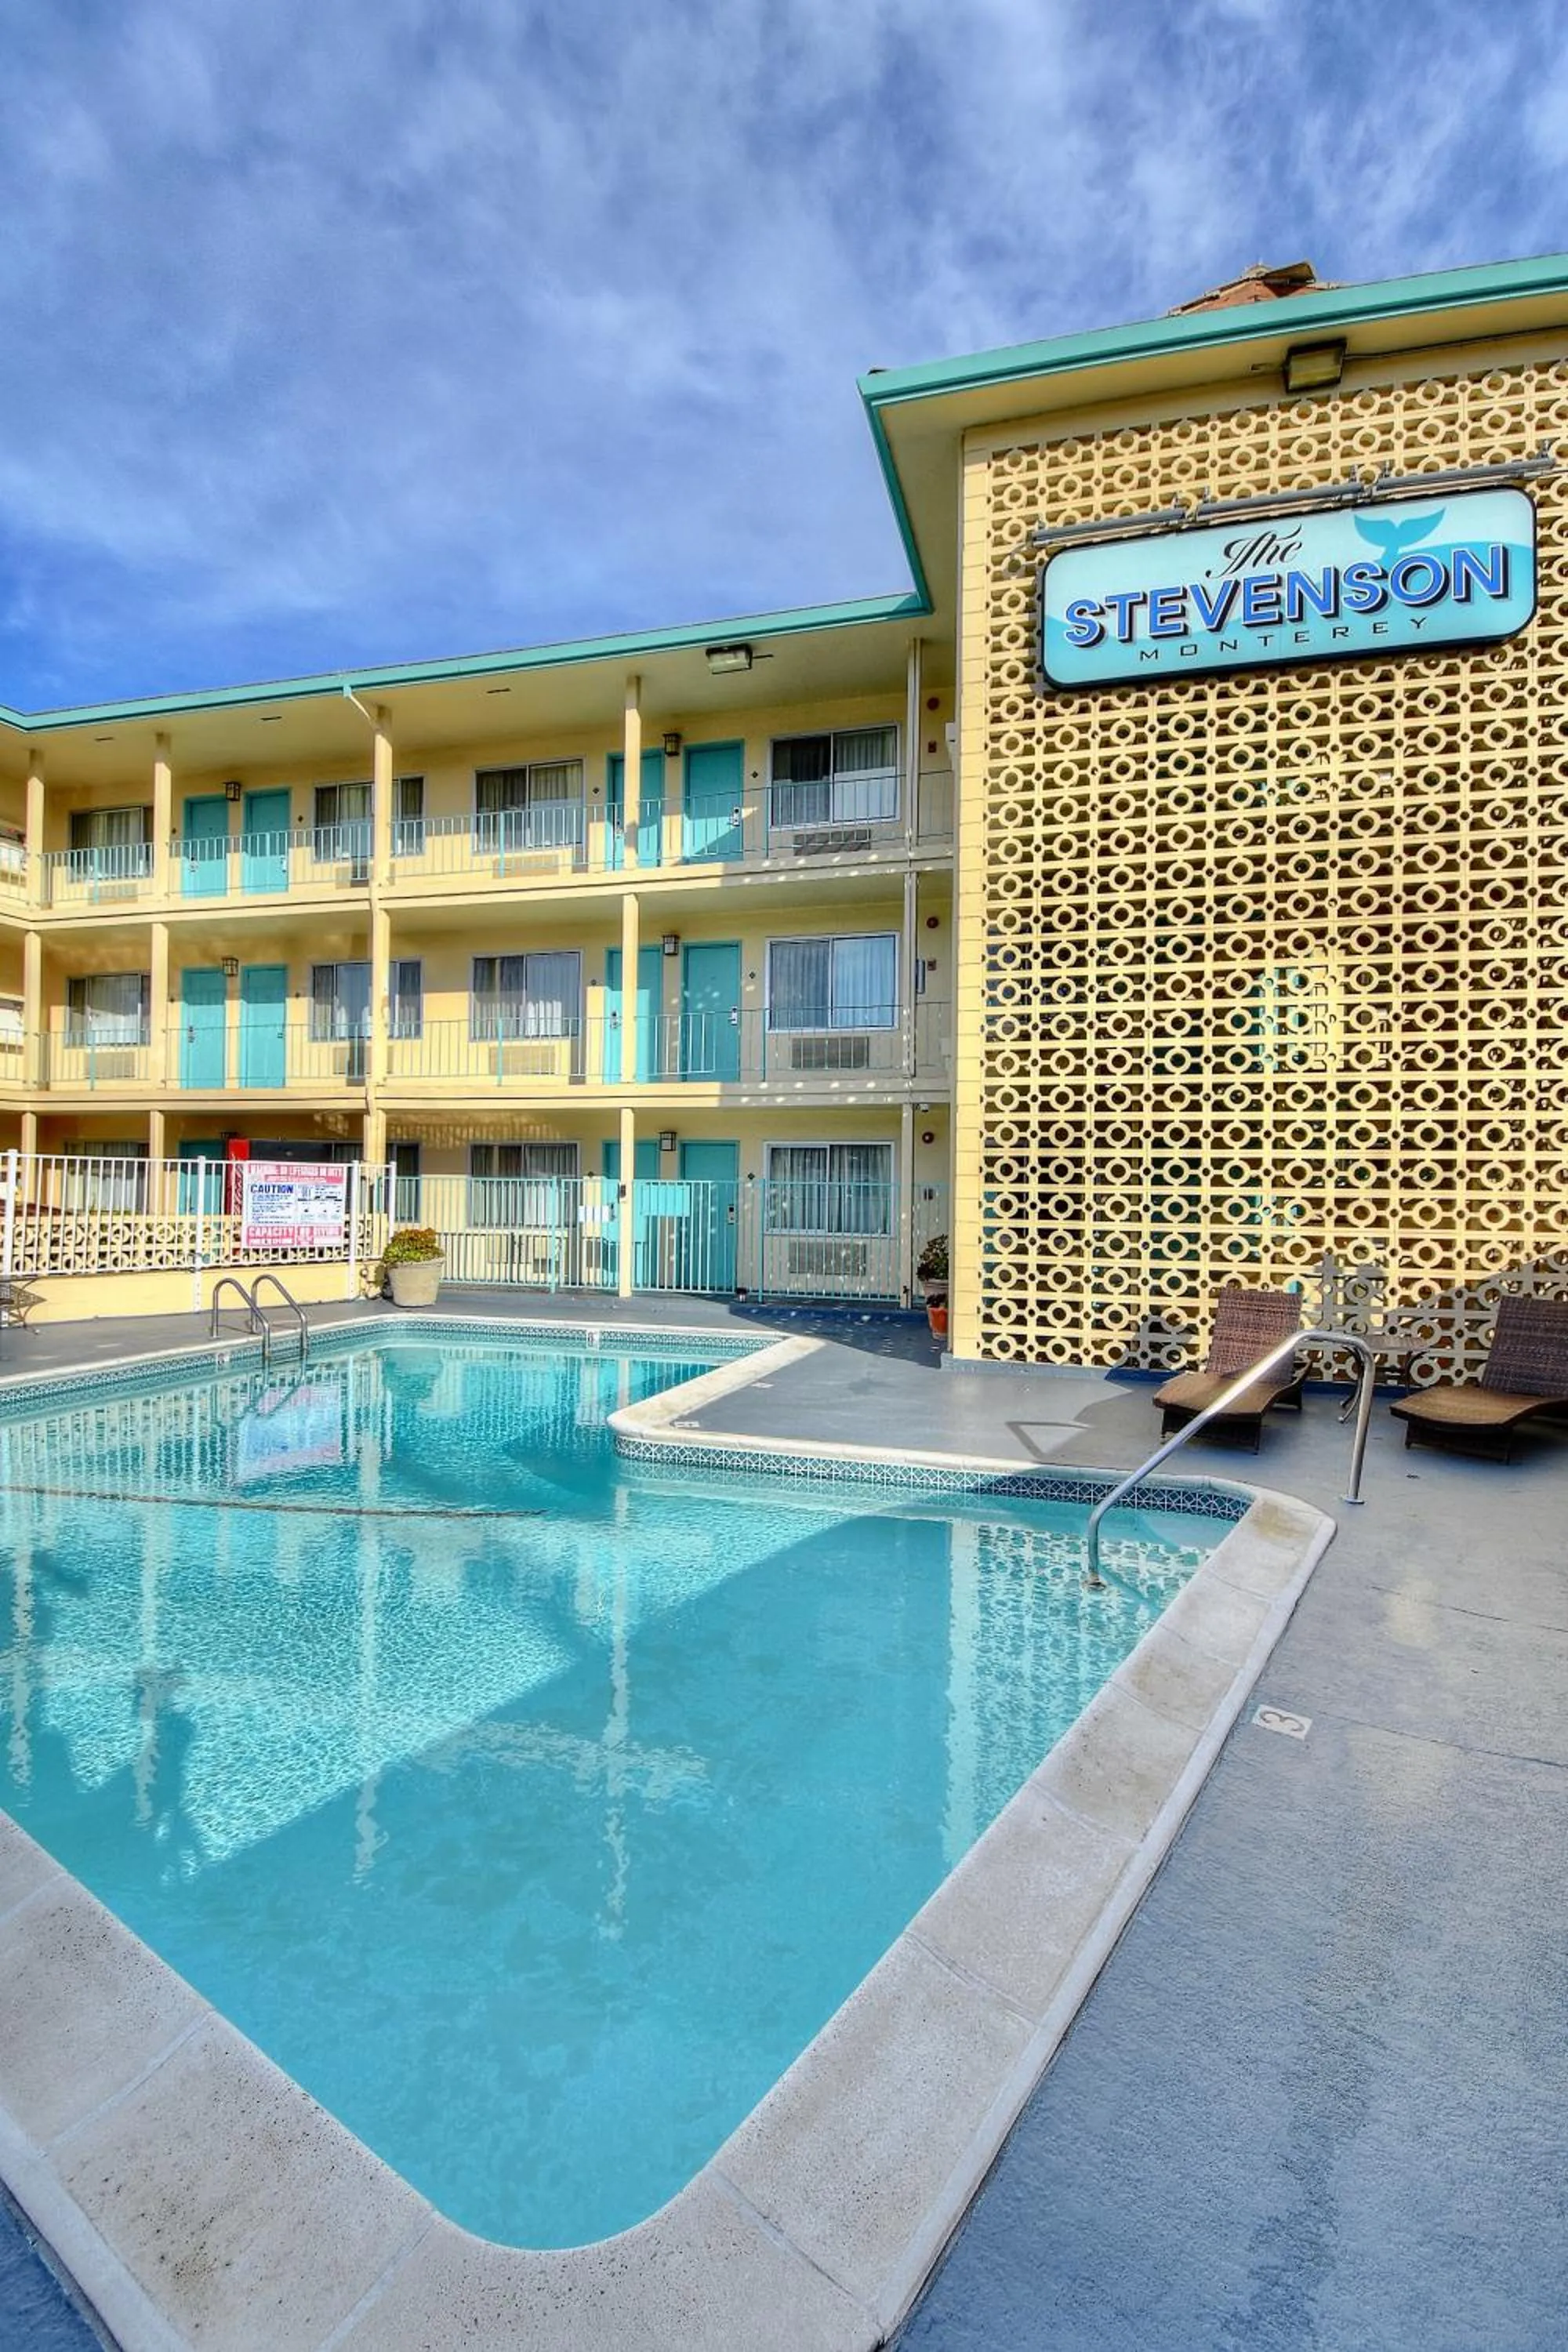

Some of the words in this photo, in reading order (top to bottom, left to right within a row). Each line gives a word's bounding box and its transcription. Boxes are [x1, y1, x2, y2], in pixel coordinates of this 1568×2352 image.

[1205, 524, 1303, 579] The
[1064, 544, 1508, 648] STEVENSON
[1140, 616, 1428, 662] MONTEREY
[250, 1184, 294, 1193] CAUTION
[248, 1226, 295, 1237] CAPACITY
[1258, 1711, 1305, 1732] 3
